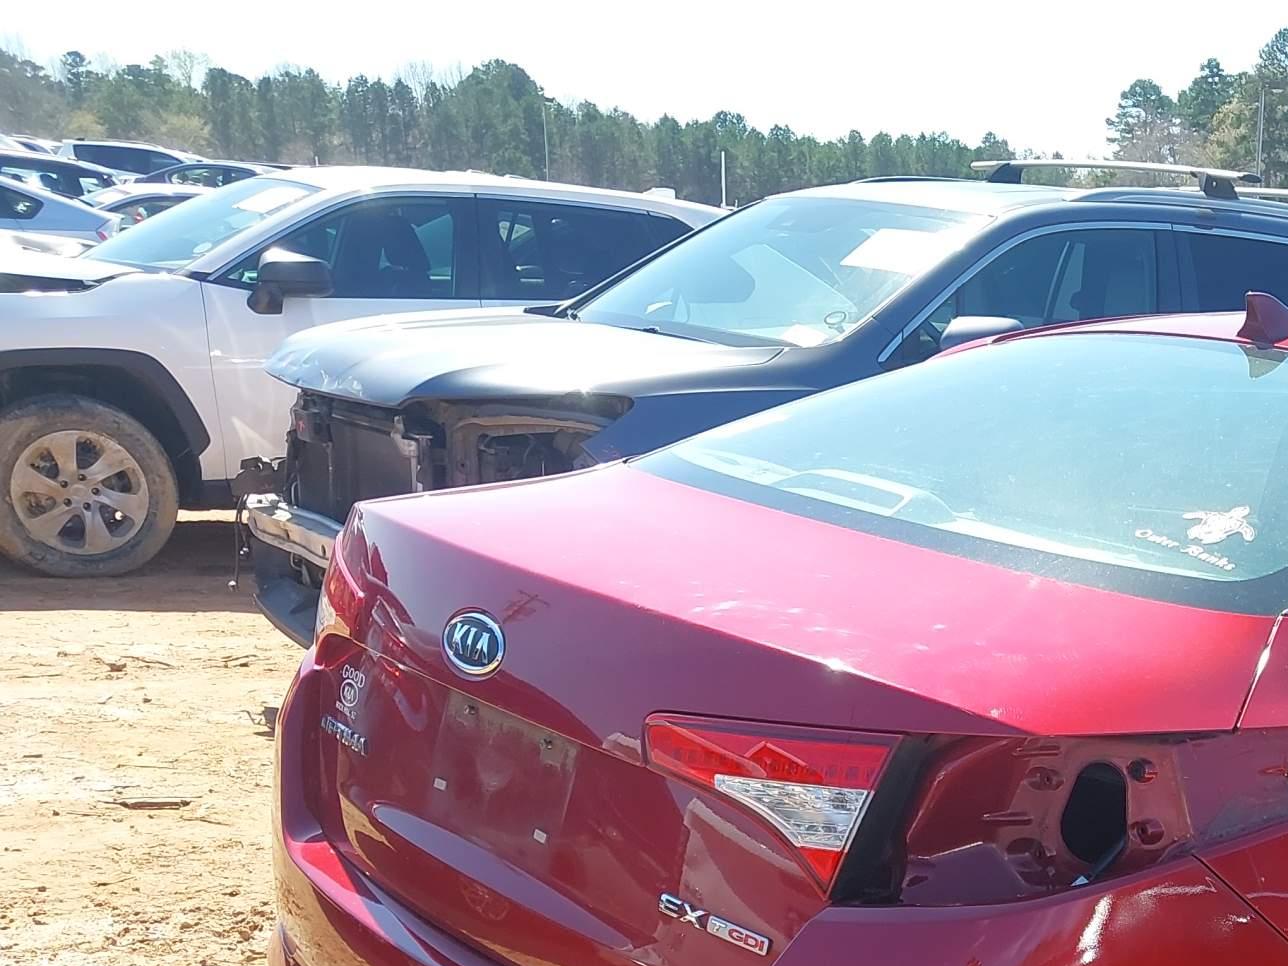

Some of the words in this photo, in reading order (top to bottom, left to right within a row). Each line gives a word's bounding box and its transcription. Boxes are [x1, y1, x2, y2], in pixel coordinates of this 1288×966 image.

[1135, 529, 1180, 549] Outer
[1180, 544, 1237, 572] Banks
[452, 622, 491, 665] KIA
[342, 664, 366, 688] GOOD
[658, 893, 709, 931] EX
